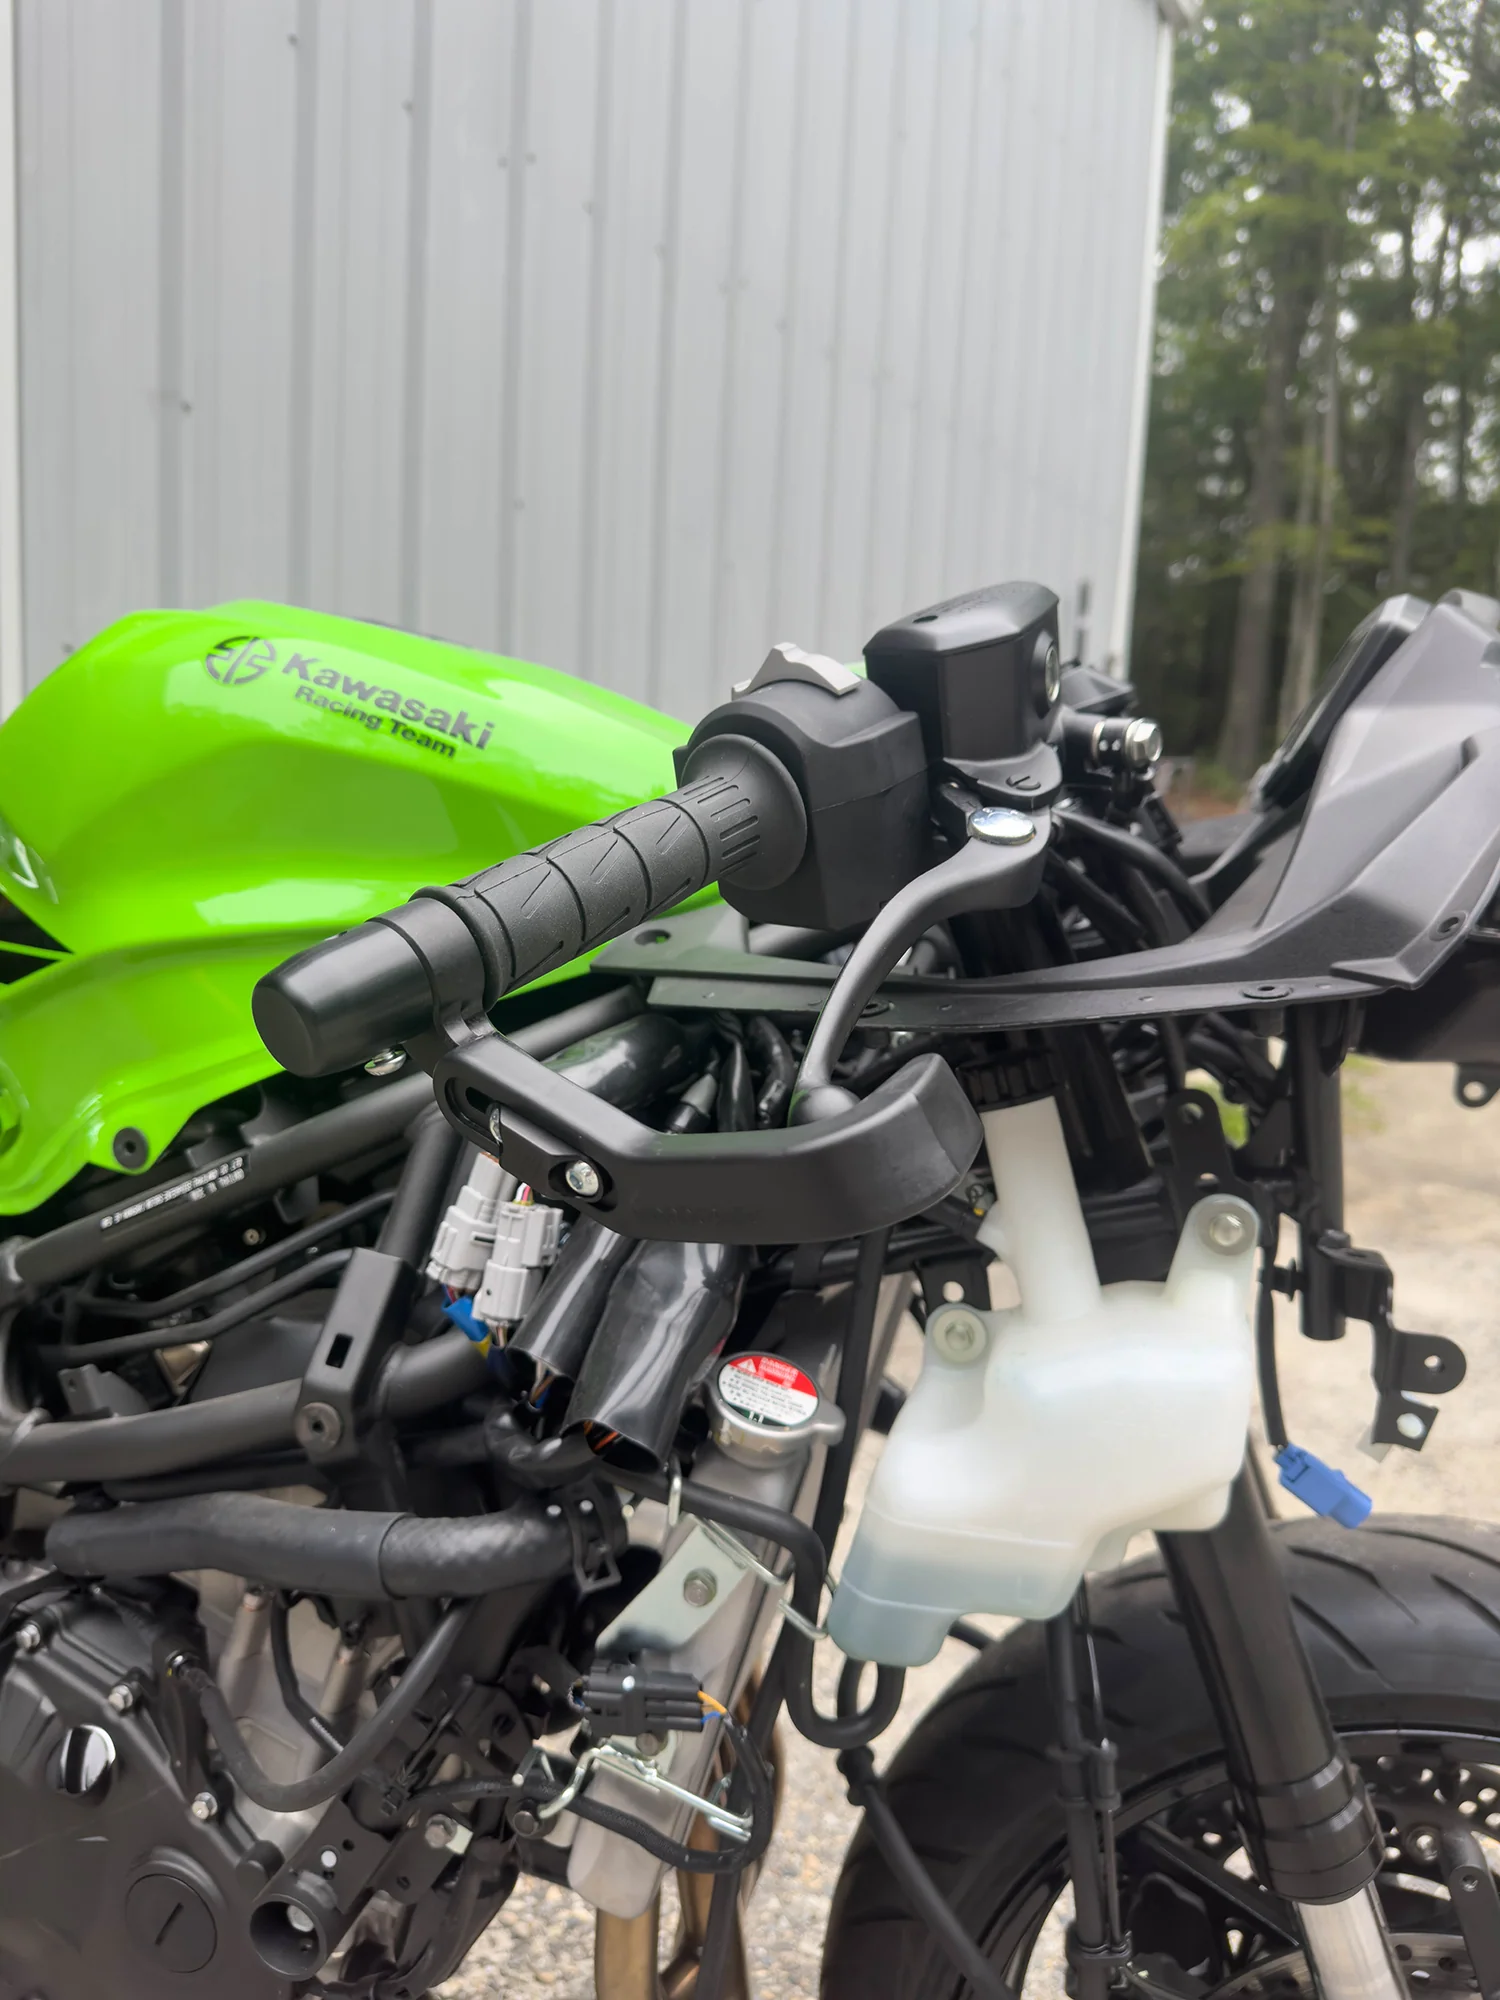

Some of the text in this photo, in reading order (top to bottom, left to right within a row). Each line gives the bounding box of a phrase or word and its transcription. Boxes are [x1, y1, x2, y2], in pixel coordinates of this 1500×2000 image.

[282, 653, 495, 750] Kawasaki
[295, 685, 457, 759] Racing Team
